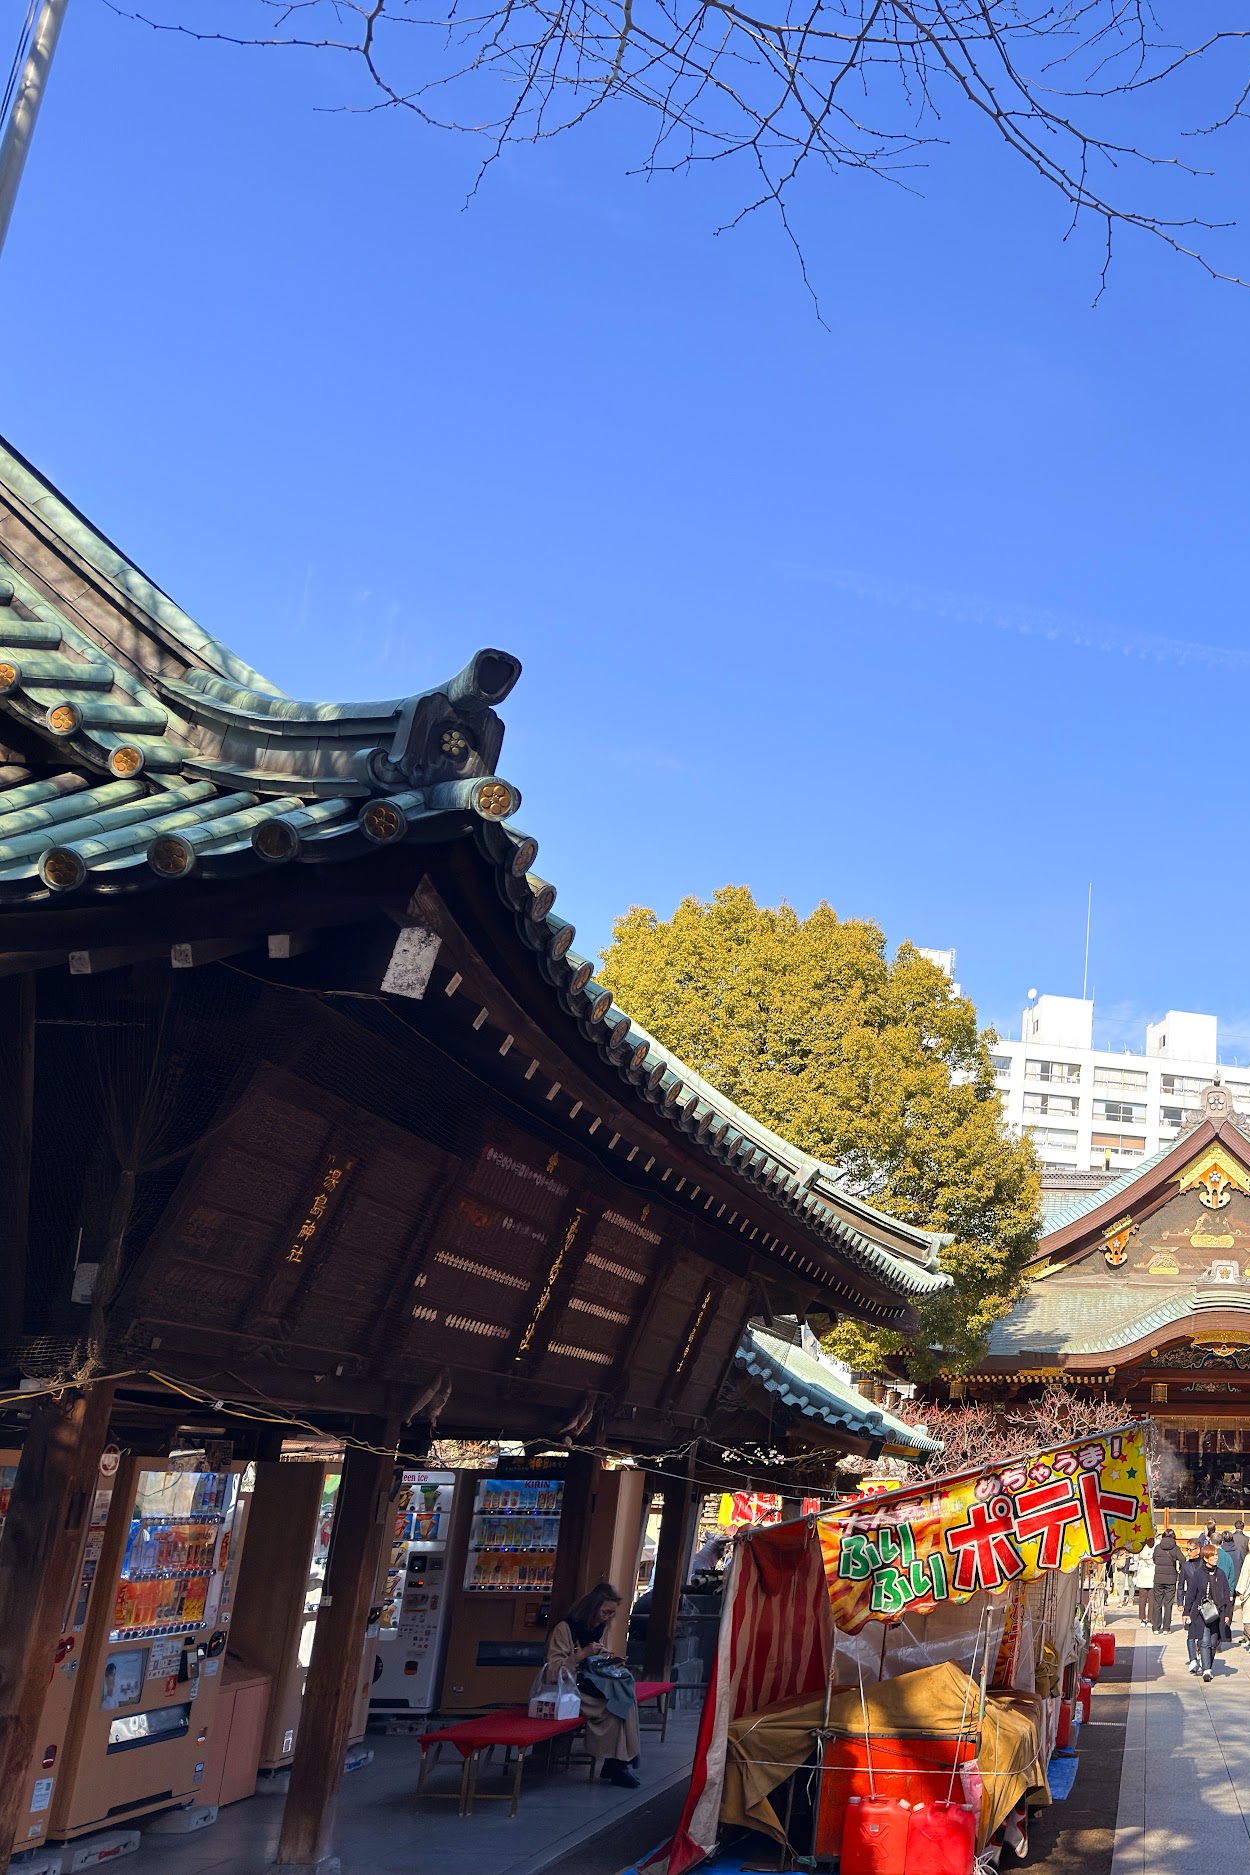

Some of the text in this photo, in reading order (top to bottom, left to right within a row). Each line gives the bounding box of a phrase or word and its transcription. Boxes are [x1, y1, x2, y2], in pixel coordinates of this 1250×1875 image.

[417, 1472, 428, 1482] ice
[525, 1480, 551, 1489] KIRIN
[945, 1471, 1140, 1592] ポテト
